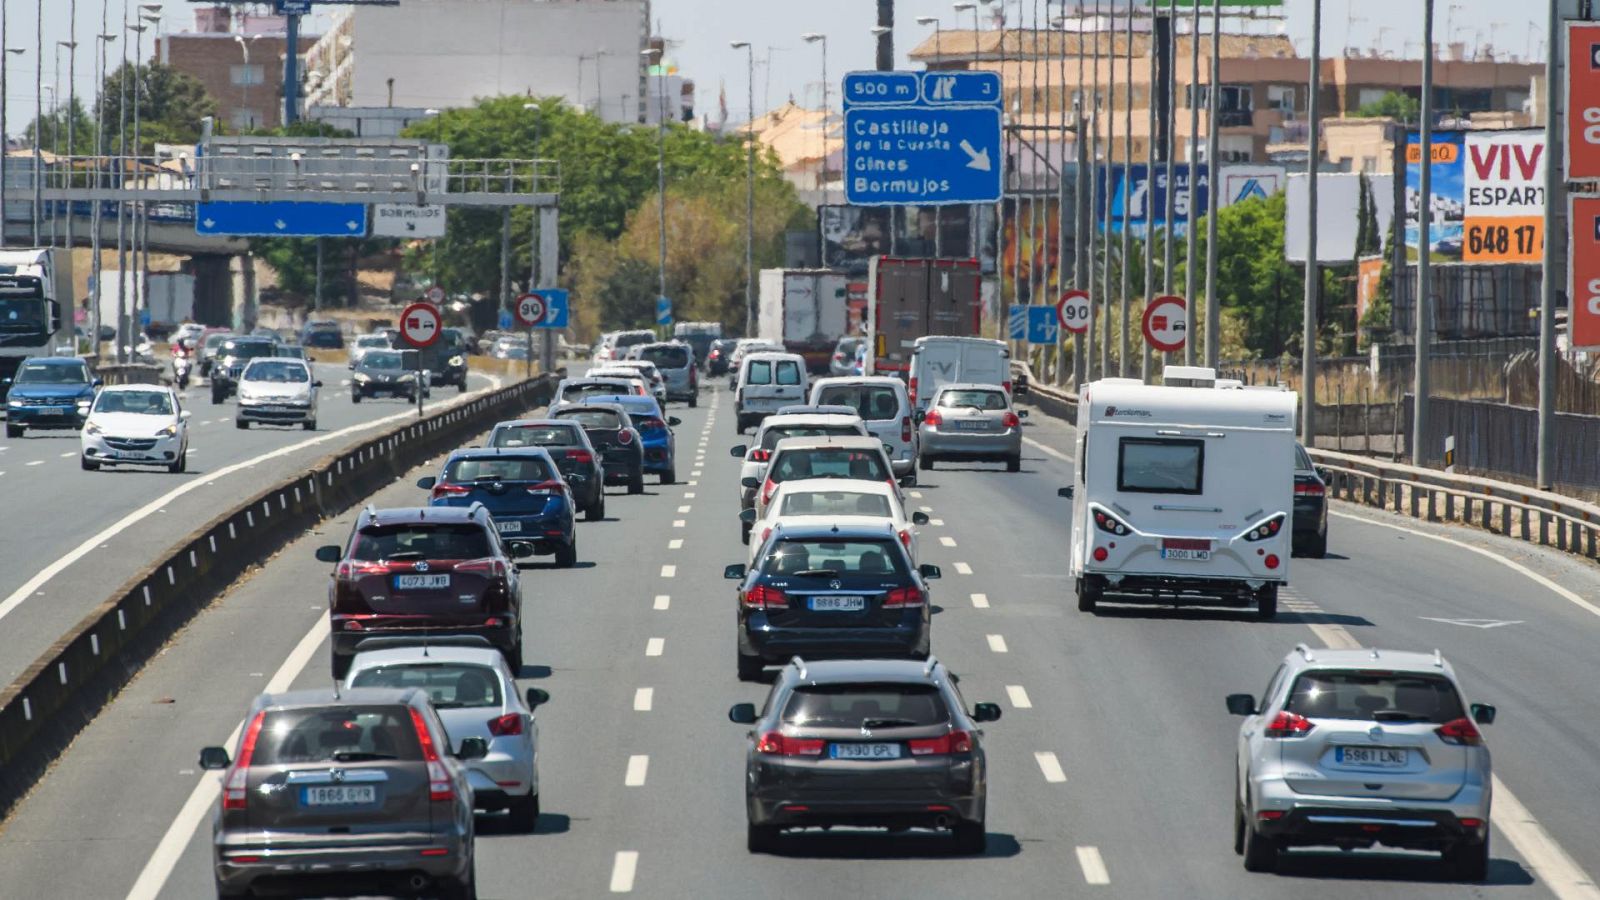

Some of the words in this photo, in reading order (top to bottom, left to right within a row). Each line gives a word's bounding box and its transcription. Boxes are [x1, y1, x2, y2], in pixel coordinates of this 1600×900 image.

[854, 82, 888, 95] 500
[895, 84, 909, 95] m
[854, 119, 949, 138] Castilleja
[855, 139, 871, 150] de
[879, 139, 891, 150] la
[898, 138, 950, 151] Cuesta
[854, 156, 909, 172] Gines
[854, 177, 950, 197] Bormujos
[1156, 174, 1208, 189] SLIA
[1469, 225, 1509, 255] 648
[1514, 225, 1535, 255] 17
[521, 303, 540, 315] 90
[1066, 304, 1088, 320] 90
